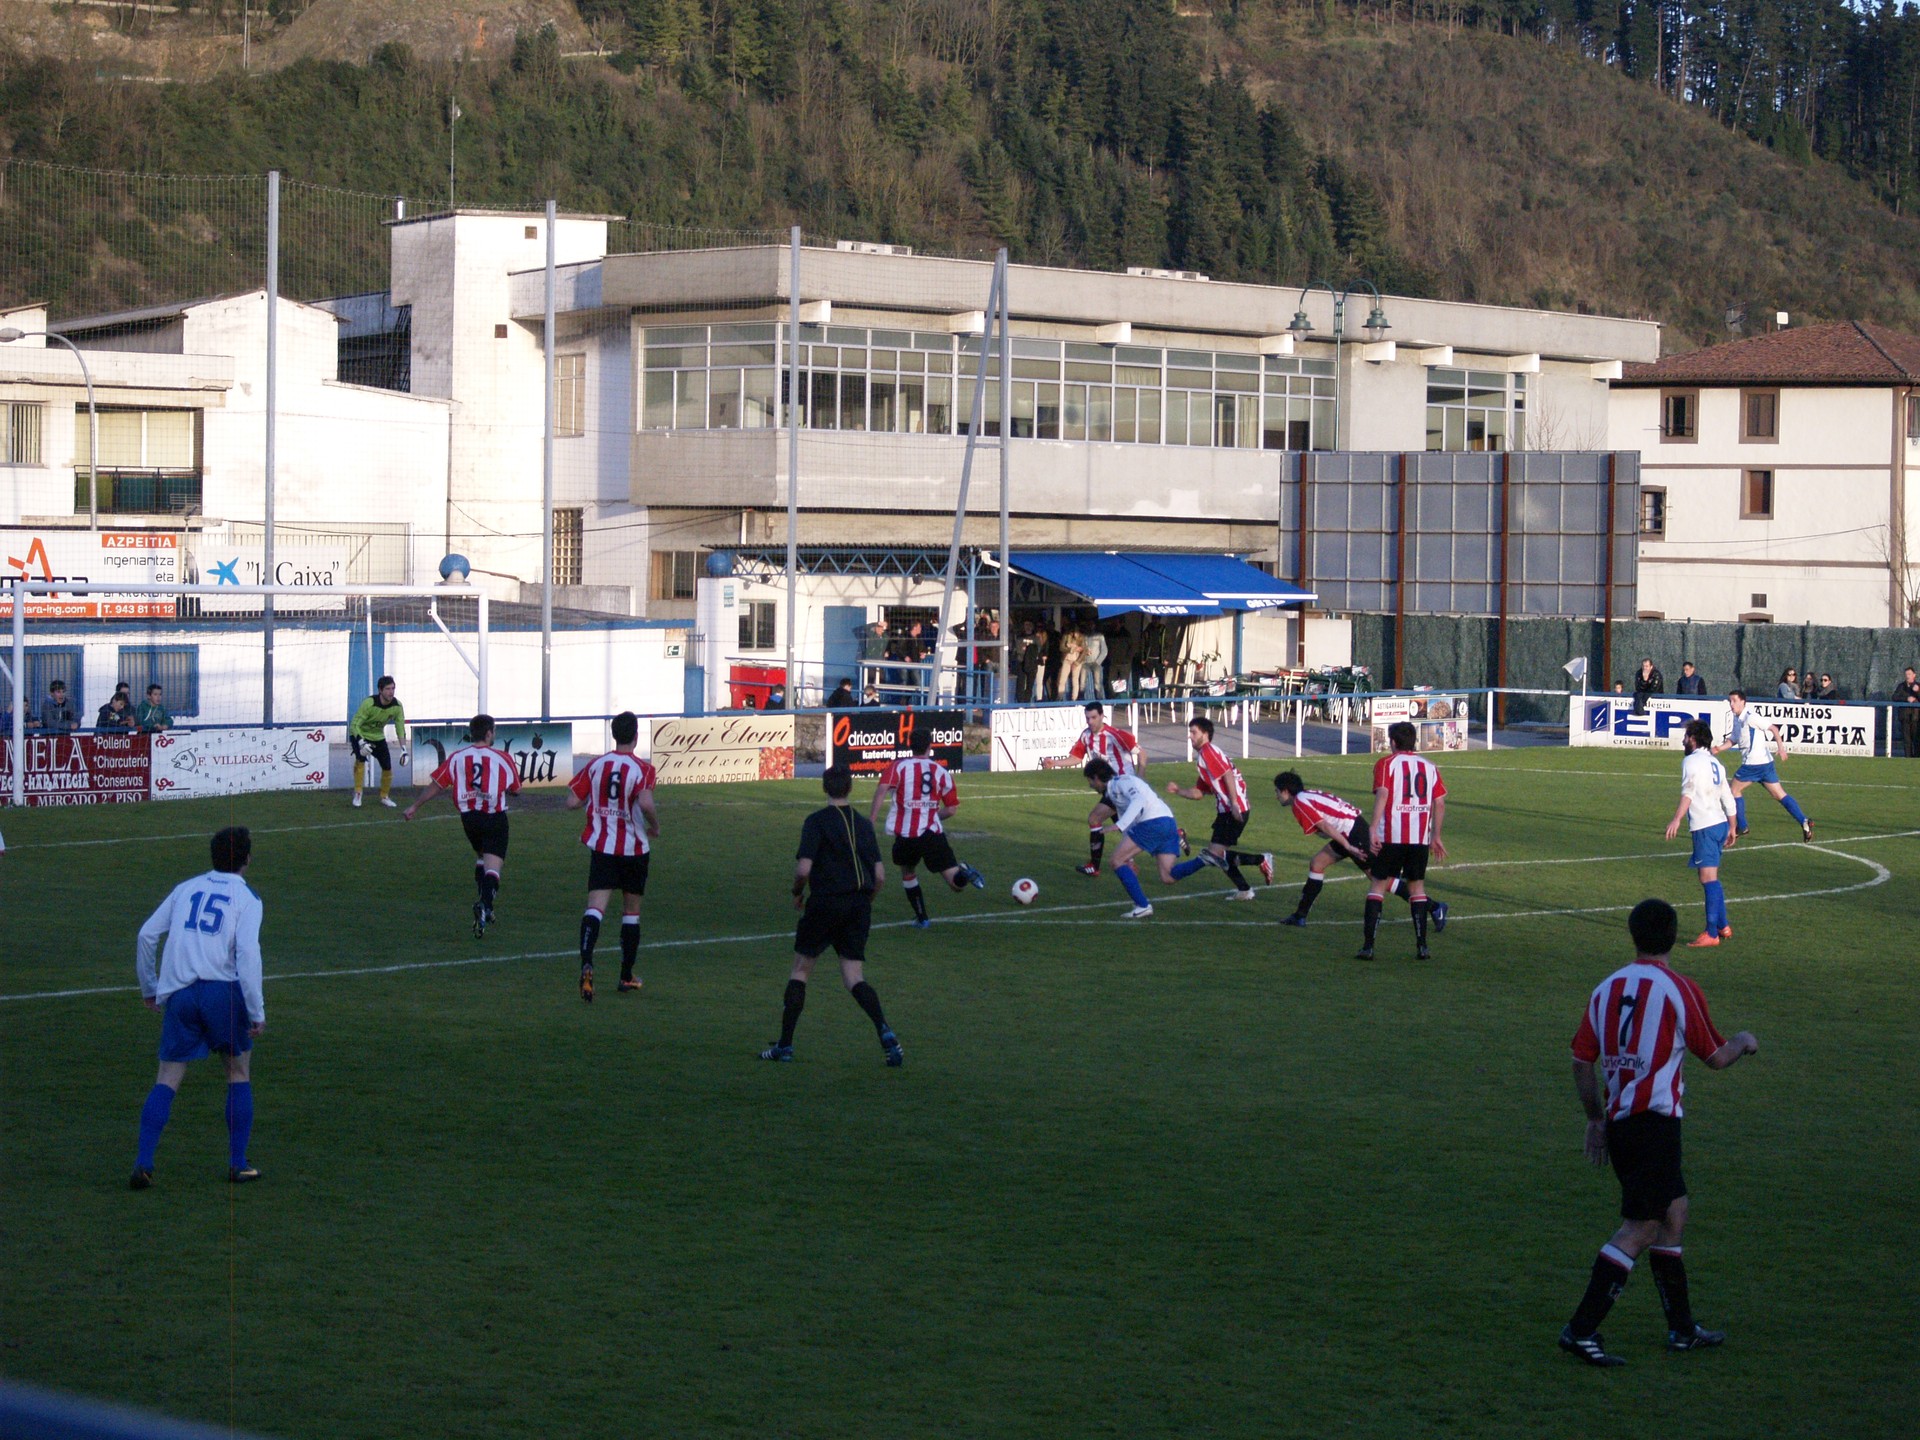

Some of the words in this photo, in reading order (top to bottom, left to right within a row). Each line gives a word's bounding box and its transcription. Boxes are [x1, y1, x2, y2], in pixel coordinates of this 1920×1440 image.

[106, 536, 172, 548] AZPEITIA
[103, 554, 174, 568] ingeniaritza
[155, 572, 174, 582] eta
[0, 604, 87, 616] w.ara-ing.com
[103, 604, 113, 614] T.
[115, 604, 134, 614] 943
[137, 604, 148, 614] 81
[151, 604, 160, 613] 11
[164, 604, 174, 613] 12
[833, 716, 895, 746] Odriozola
[899, 713, 963, 747] Htegia
[994, 711, 1056, 733] PINTURAS
[1614, 709, 1711, 738] EPI
[653, 720, 714, 753] Ongi
[720, 718, 793, 745] Etorri
[213, 754, 274, 766] VILLEGAS
[862, 751, 896, 760] katering
[97, 775, 144, 788] Conservas
[472, 762, 483, 790] 2
[921, 771, 933, 795] 8
[1711, 761, 1721, 785] 9
[607, 771, 621, 800] 6
[1402, 772, 1428, 798] 10
[38, 794, 97, 807] MERCADO
[116, 792, 142, 803] PISO
[184, 891, 231, 936] 15
[1619, 995, 1639, 1047] 7
